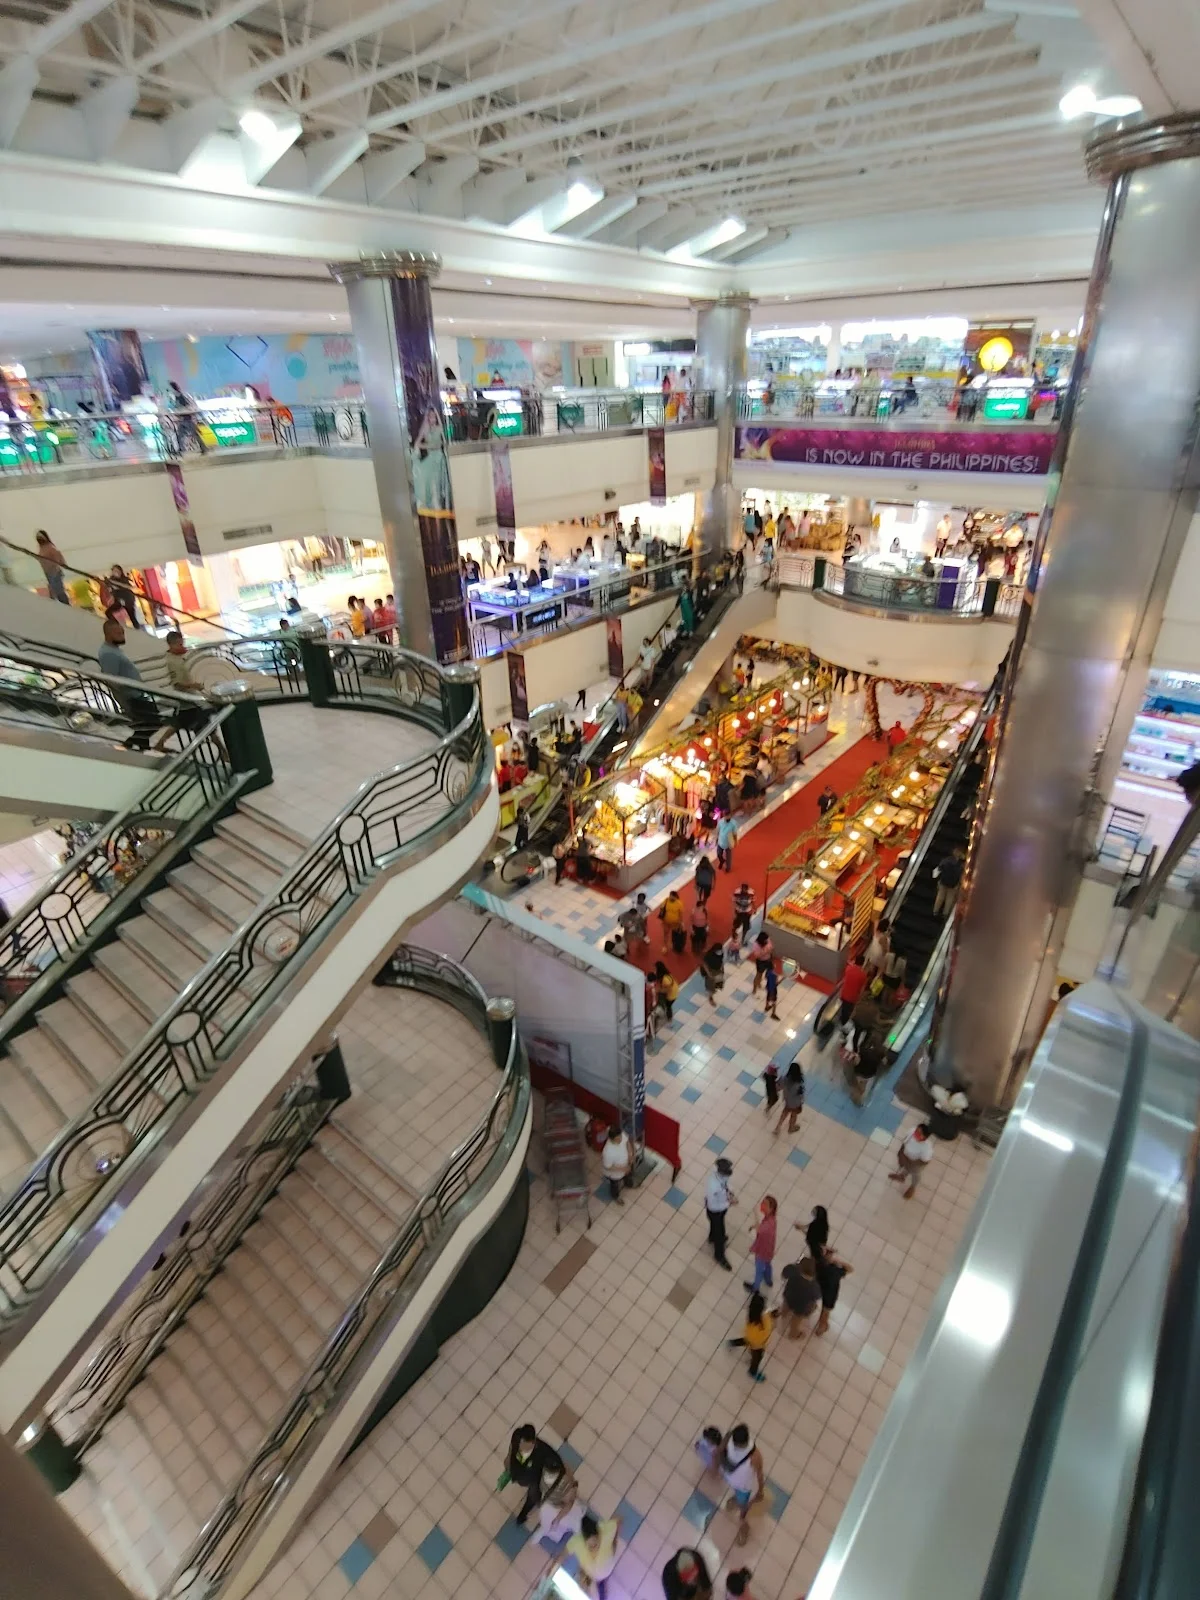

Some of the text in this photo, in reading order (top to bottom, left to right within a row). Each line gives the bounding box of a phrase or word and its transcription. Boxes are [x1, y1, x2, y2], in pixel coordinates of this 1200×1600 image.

[805, 447, 1040, 473] IS NOW IN THE PHILIPPINES!
